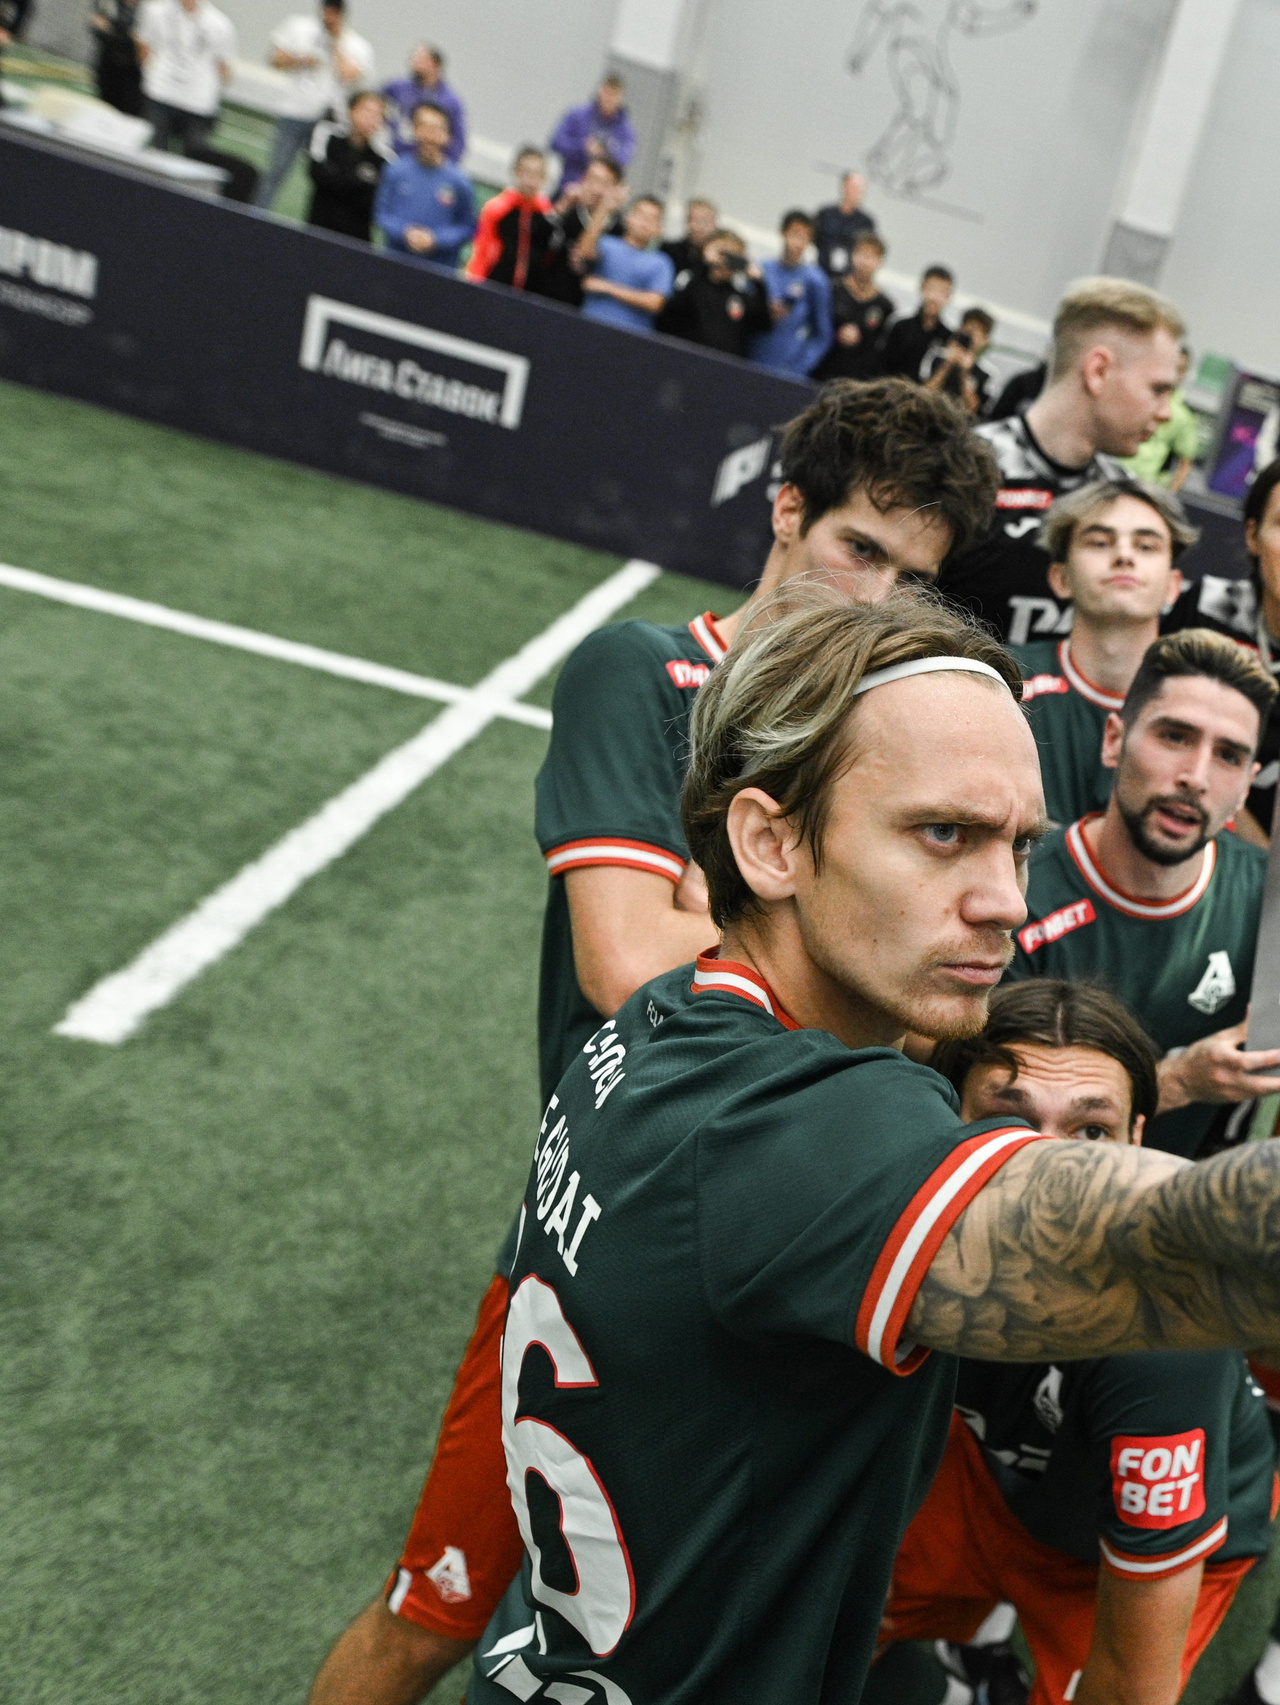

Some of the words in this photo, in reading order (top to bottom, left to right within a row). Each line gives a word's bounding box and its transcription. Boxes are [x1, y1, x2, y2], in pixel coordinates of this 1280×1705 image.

[323, 338, 394, 394] Лига
[394, 359, 502, 424] Ставок
[1118, 1439, 1201, 1480] FON
[1121, 1473, 1199, 1516] BET
